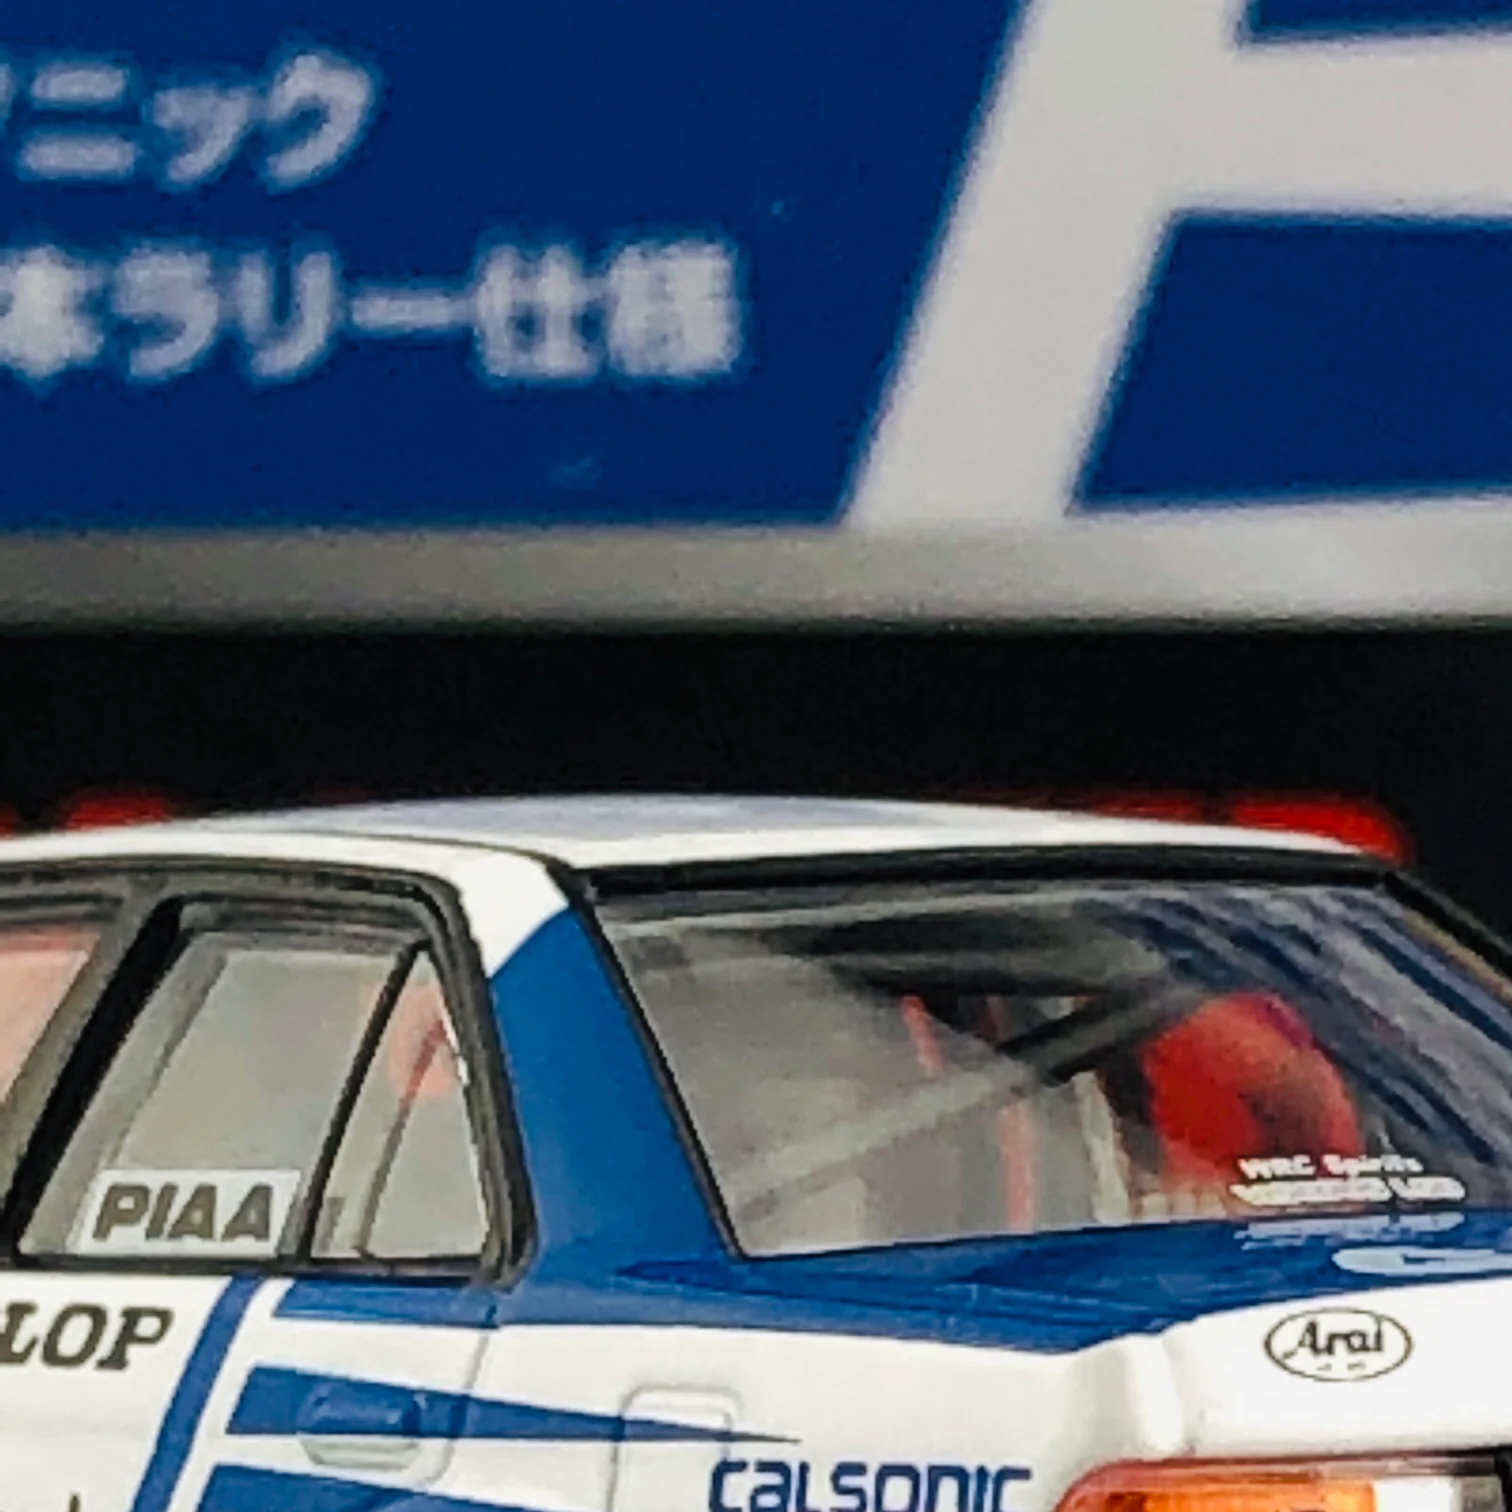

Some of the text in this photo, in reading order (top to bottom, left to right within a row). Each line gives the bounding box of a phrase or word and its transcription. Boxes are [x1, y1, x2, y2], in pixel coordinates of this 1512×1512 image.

[0, 50, 376, 186] ニック
[92, 1182, 273, 1242] PIAA
